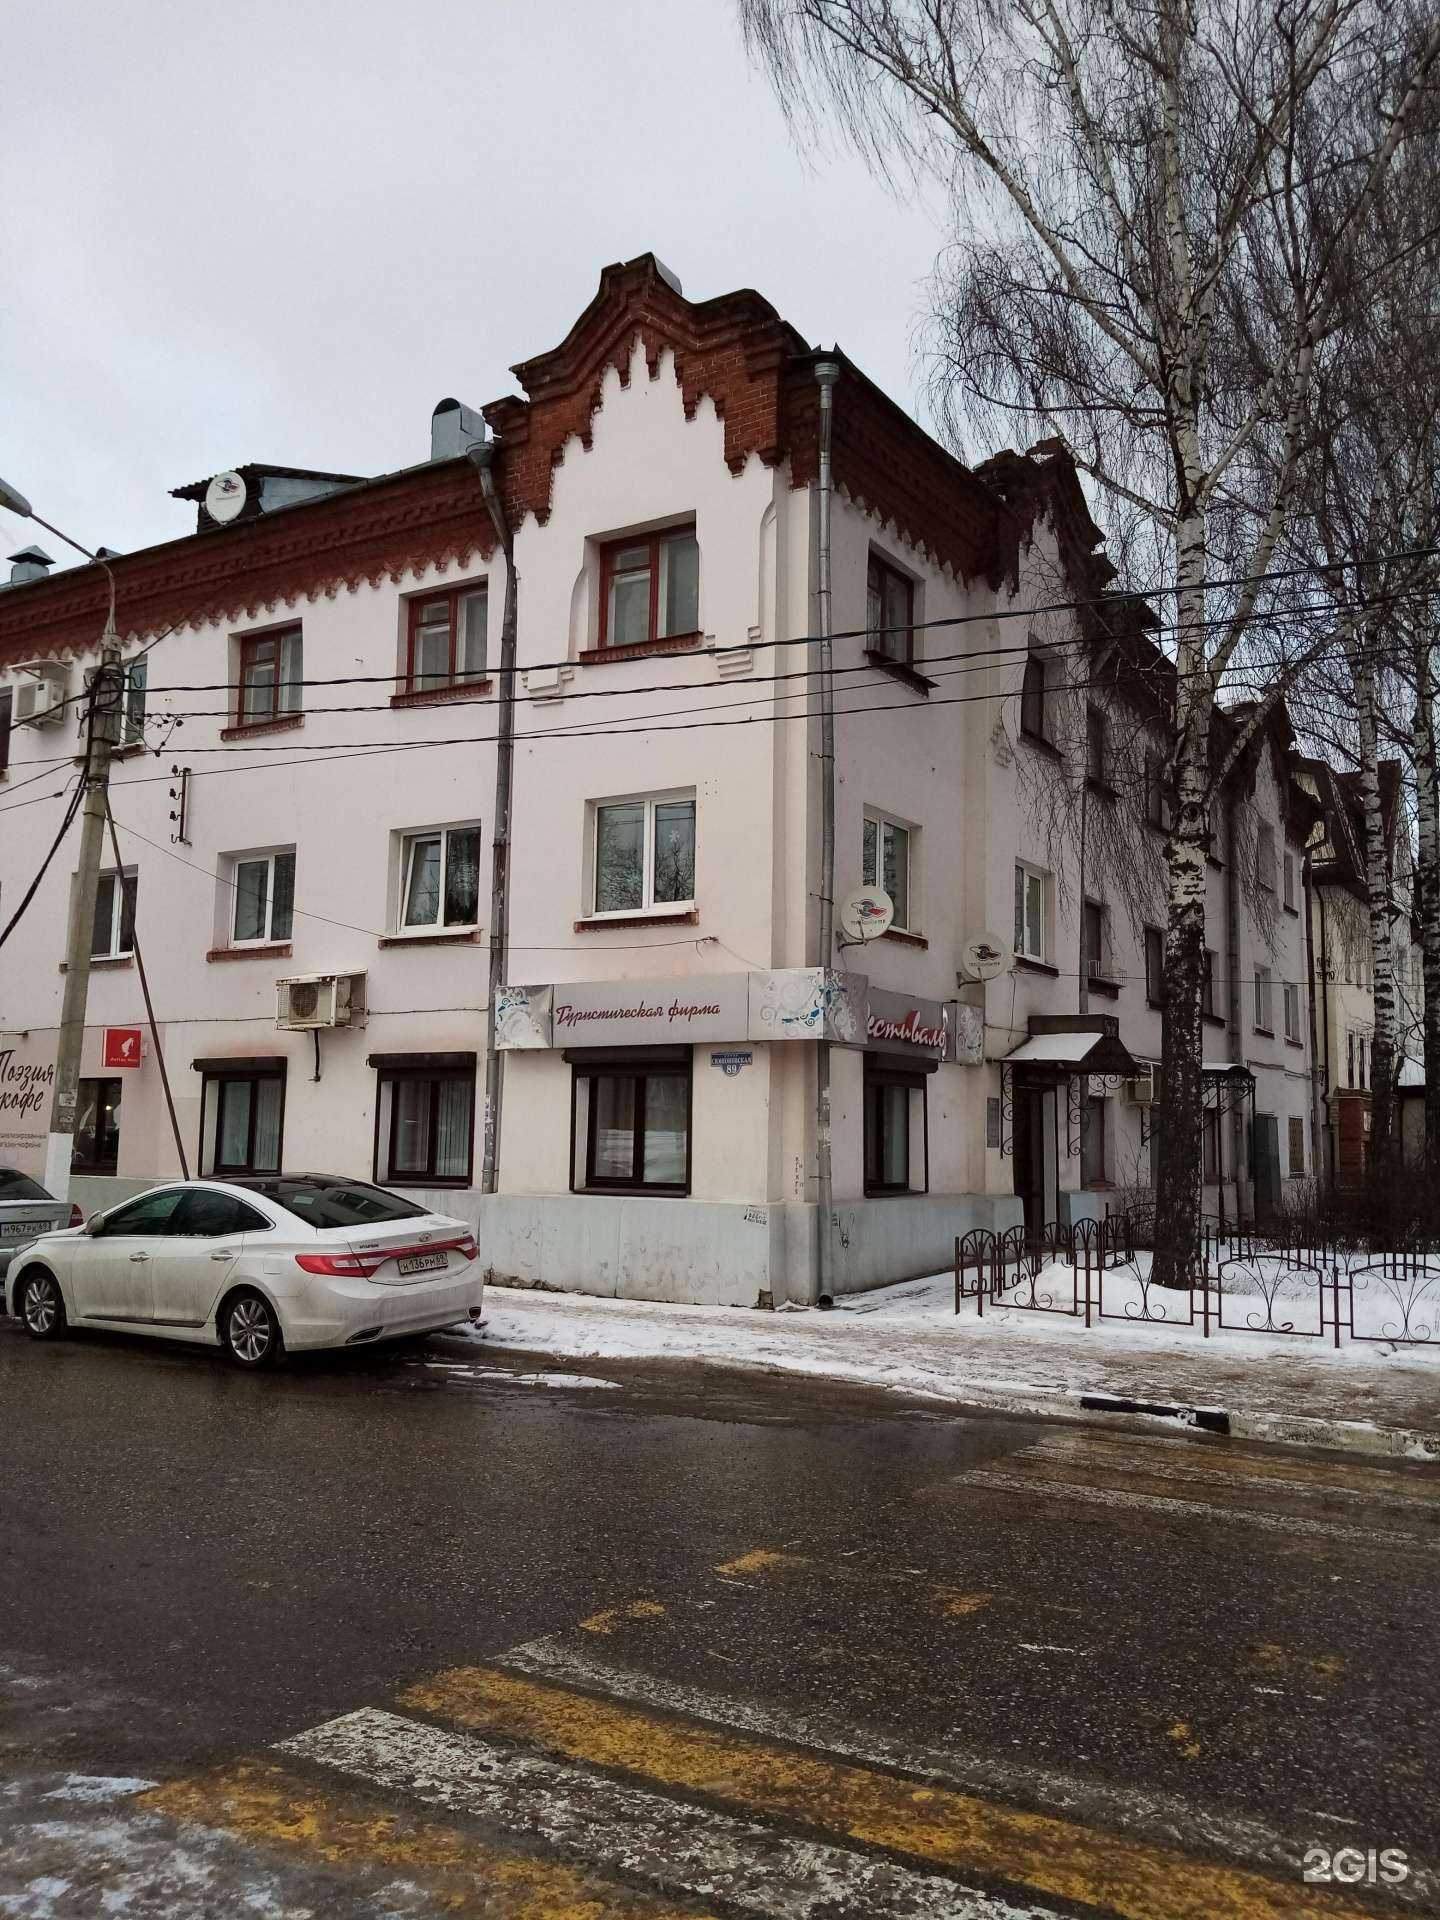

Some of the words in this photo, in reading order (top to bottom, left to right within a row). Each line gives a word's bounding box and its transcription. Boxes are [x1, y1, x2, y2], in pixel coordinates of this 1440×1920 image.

[556, 1001, 664, 1027] Туристическая
[668, 998, 721, 1023] фирма
[867, 1004, 945, 1048] естиваль
[726, 1064, 737, 1074] 89
